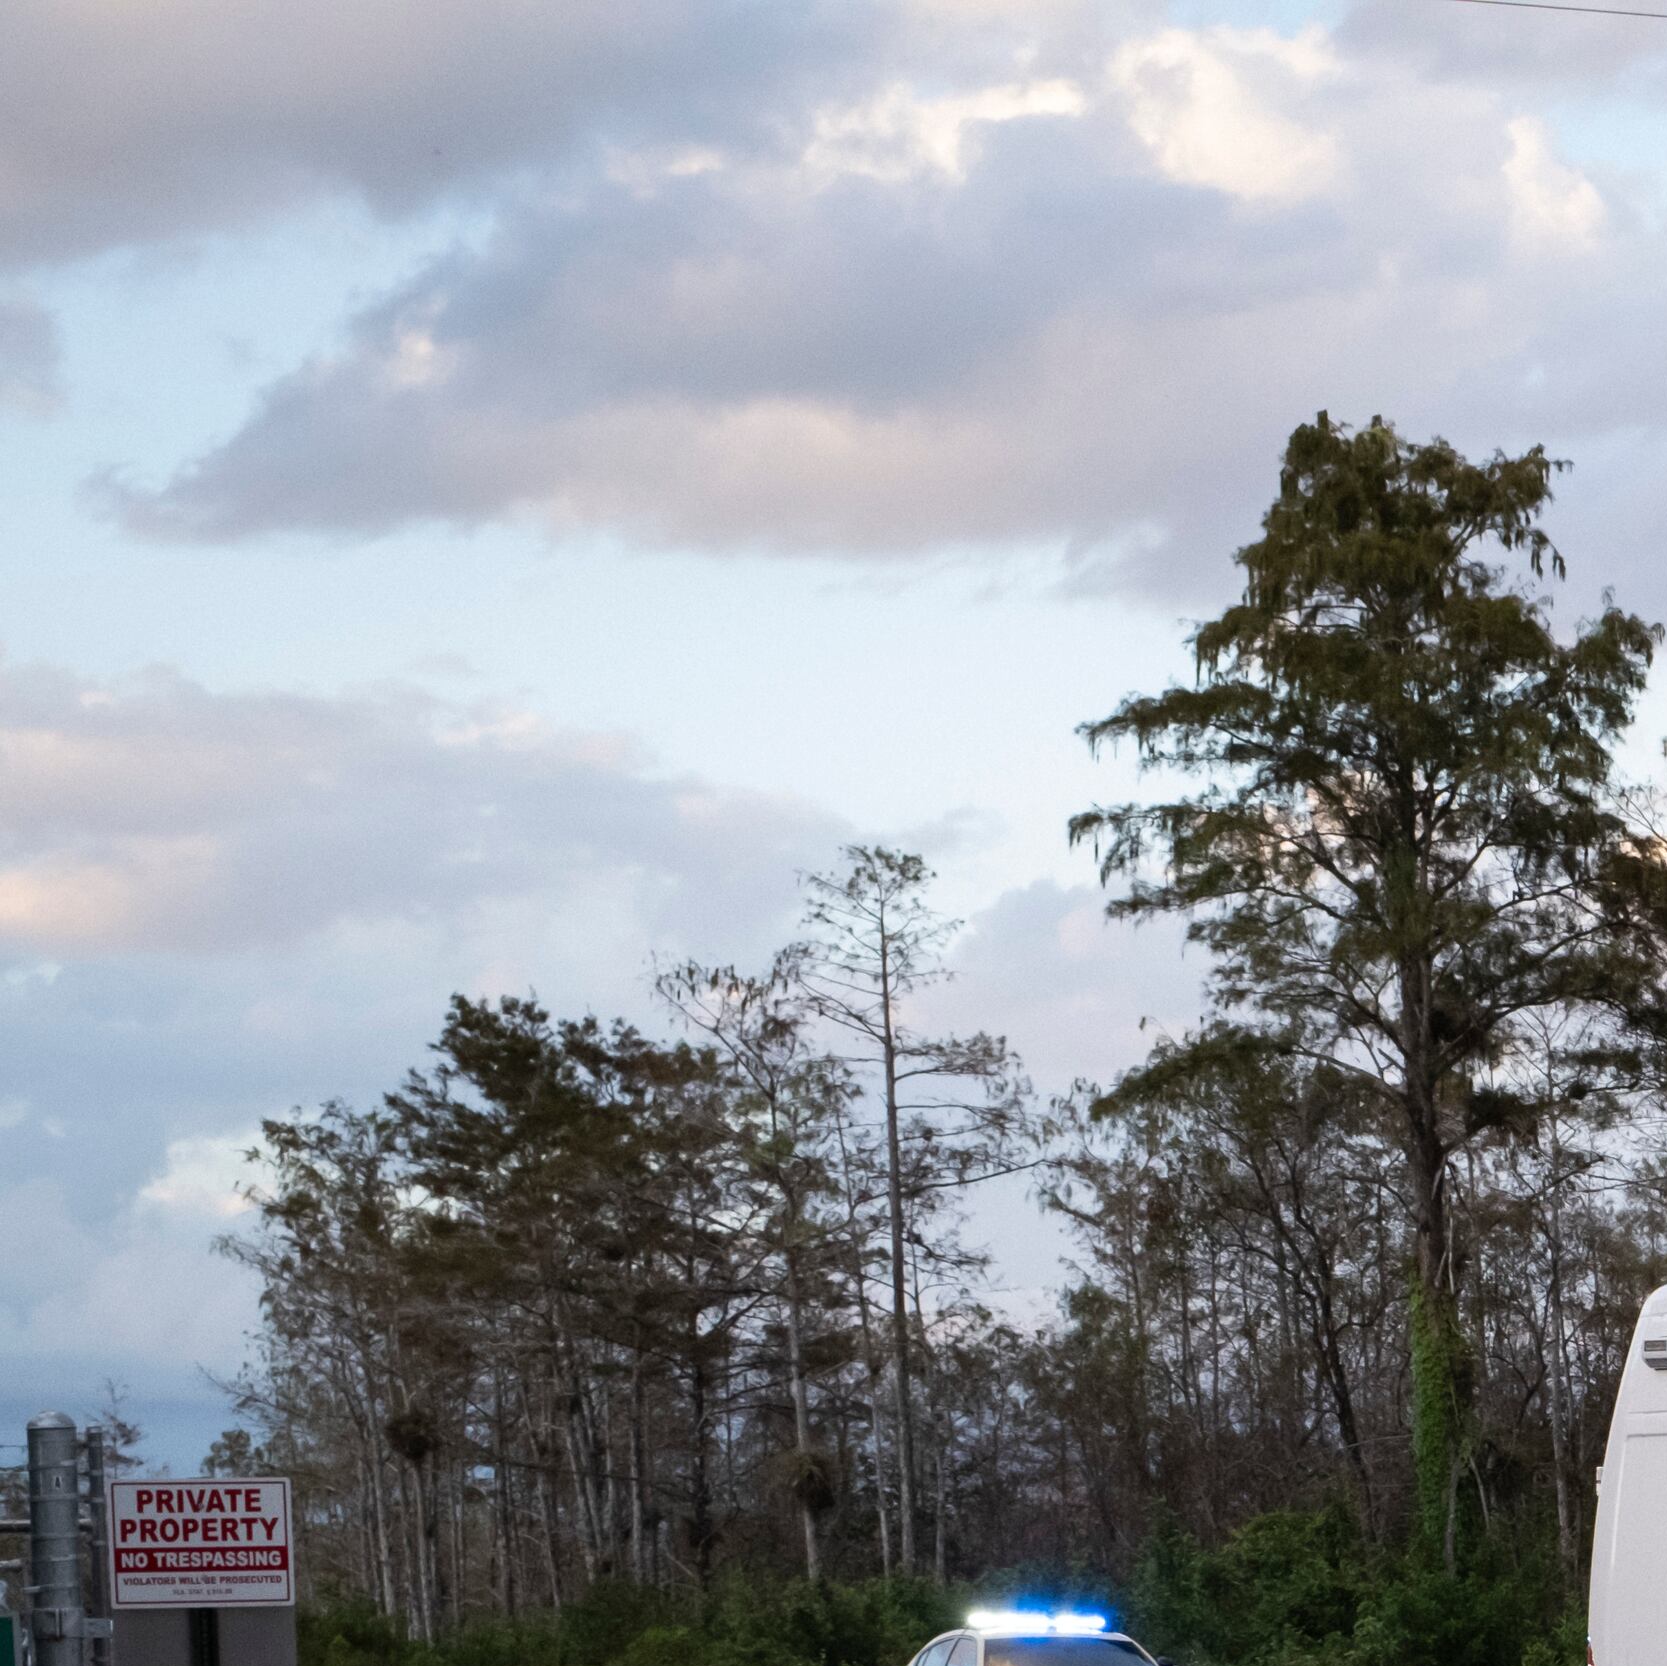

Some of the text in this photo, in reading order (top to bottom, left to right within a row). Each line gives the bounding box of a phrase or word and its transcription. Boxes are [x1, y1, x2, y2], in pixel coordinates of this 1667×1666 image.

[136, 1488, 262, 1514] PRIVATE
[120, 1517, 279, 1543] PROPERTY
[121, 1550, 282, 1569] NO TRESPASSING
[123, 1576, 176, 1586] VIOLATORS
[179, 1576, 202, 1585] WILL
[219, 1575, 282, 1585] PROSECUTED
